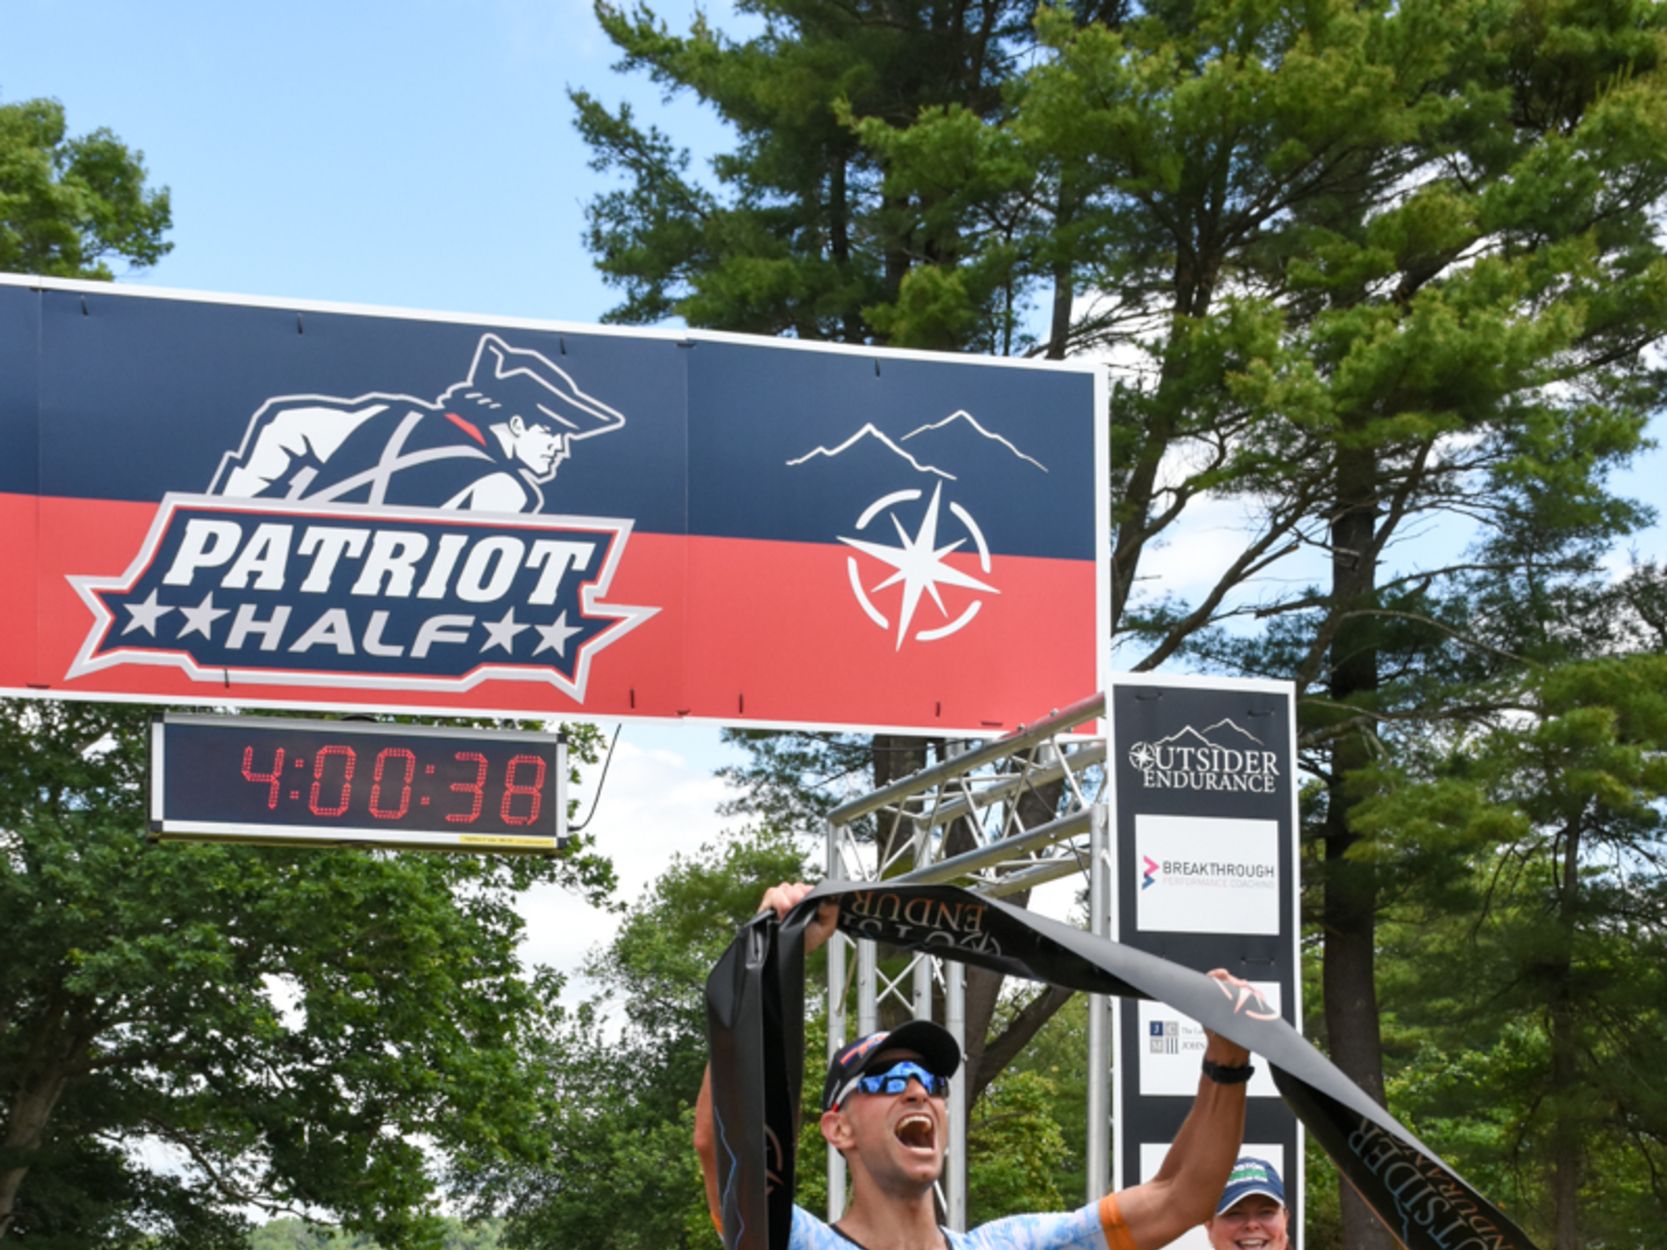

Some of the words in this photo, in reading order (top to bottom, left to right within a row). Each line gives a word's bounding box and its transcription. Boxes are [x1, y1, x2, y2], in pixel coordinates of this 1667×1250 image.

[163, 518, 596, 605] PATRIOT
[224, 603, 476, 658] HALF
[1128, 741, 1280, 777] OUTSIDER
[241, 744, 547, 826] 4:00:38
[1143, 769, 1276, 793] ENDURANCE
[1162, 860, 1275, 878] BREAKTHROUGH
[852, 890, 986, 933] ENDUR
